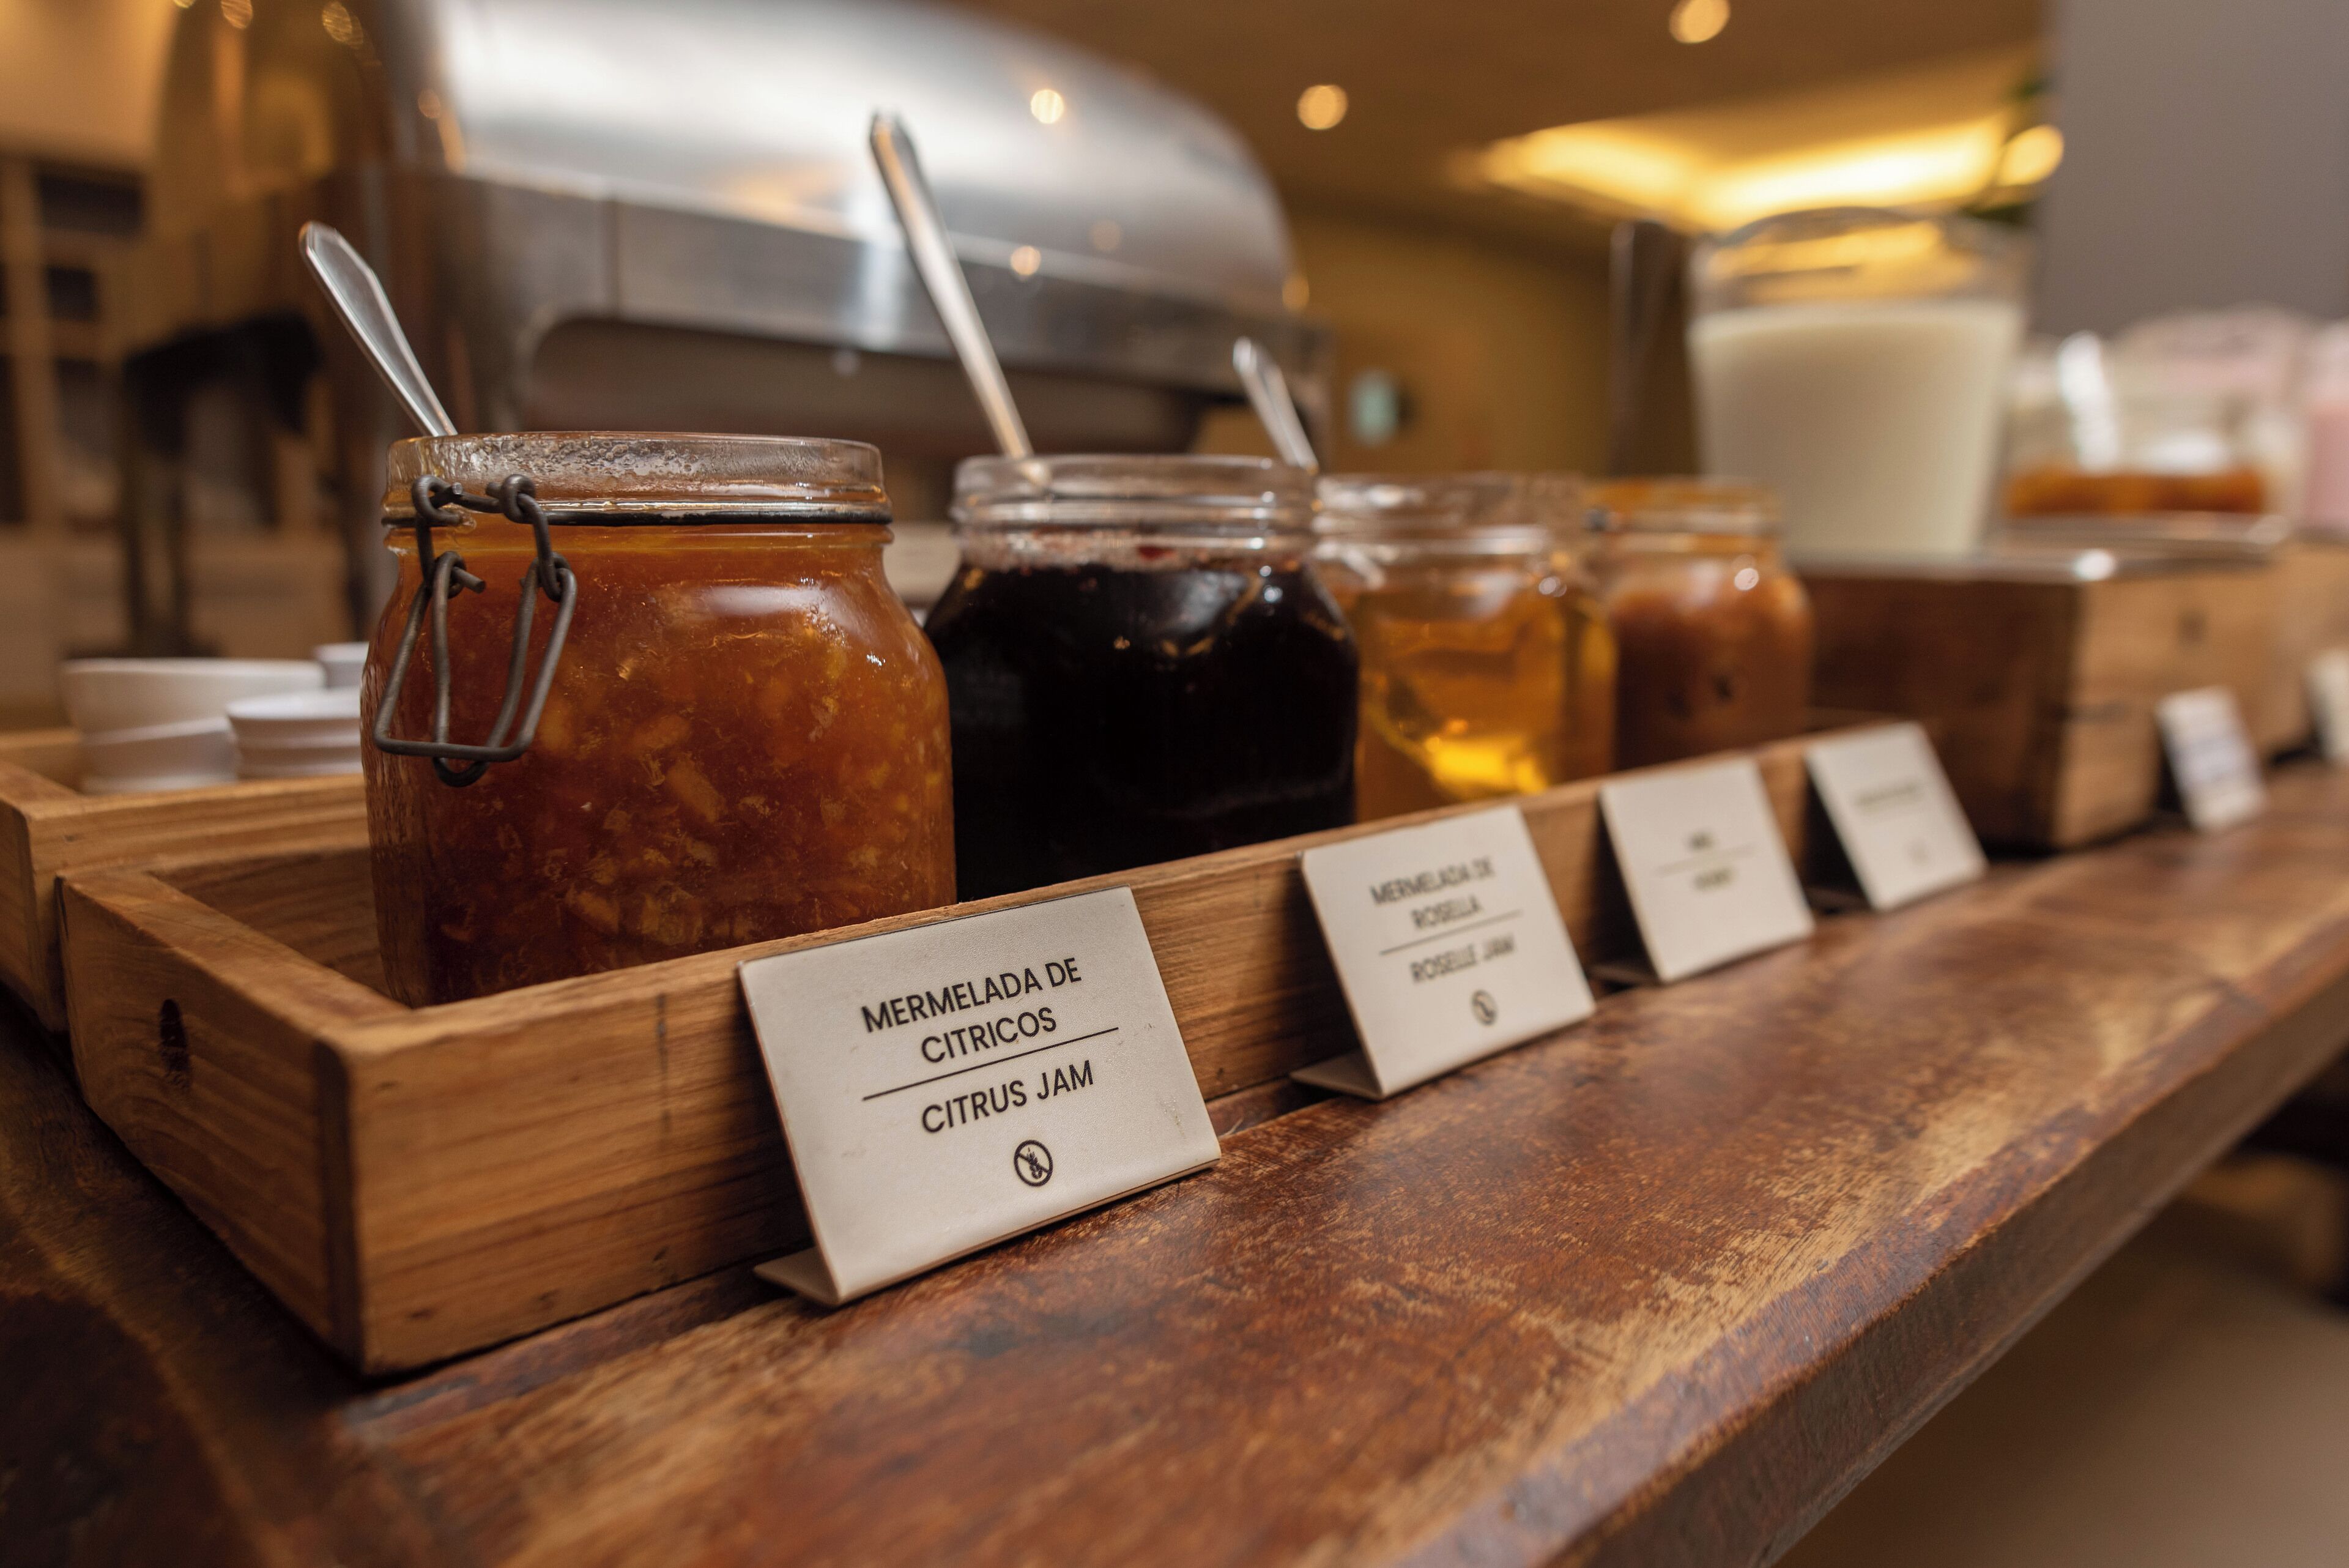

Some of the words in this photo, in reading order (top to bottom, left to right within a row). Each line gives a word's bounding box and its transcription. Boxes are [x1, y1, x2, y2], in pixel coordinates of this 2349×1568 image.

[861, 967, 1043, 1033] MERMELADA
[1045, 957, 1082, 987] DE
[921, 1007, 1057, 1063] CITRICOS
[922, 1080, 1028, 1133] CITRUS
[1037, 1060, 1094, 1100] JAM
